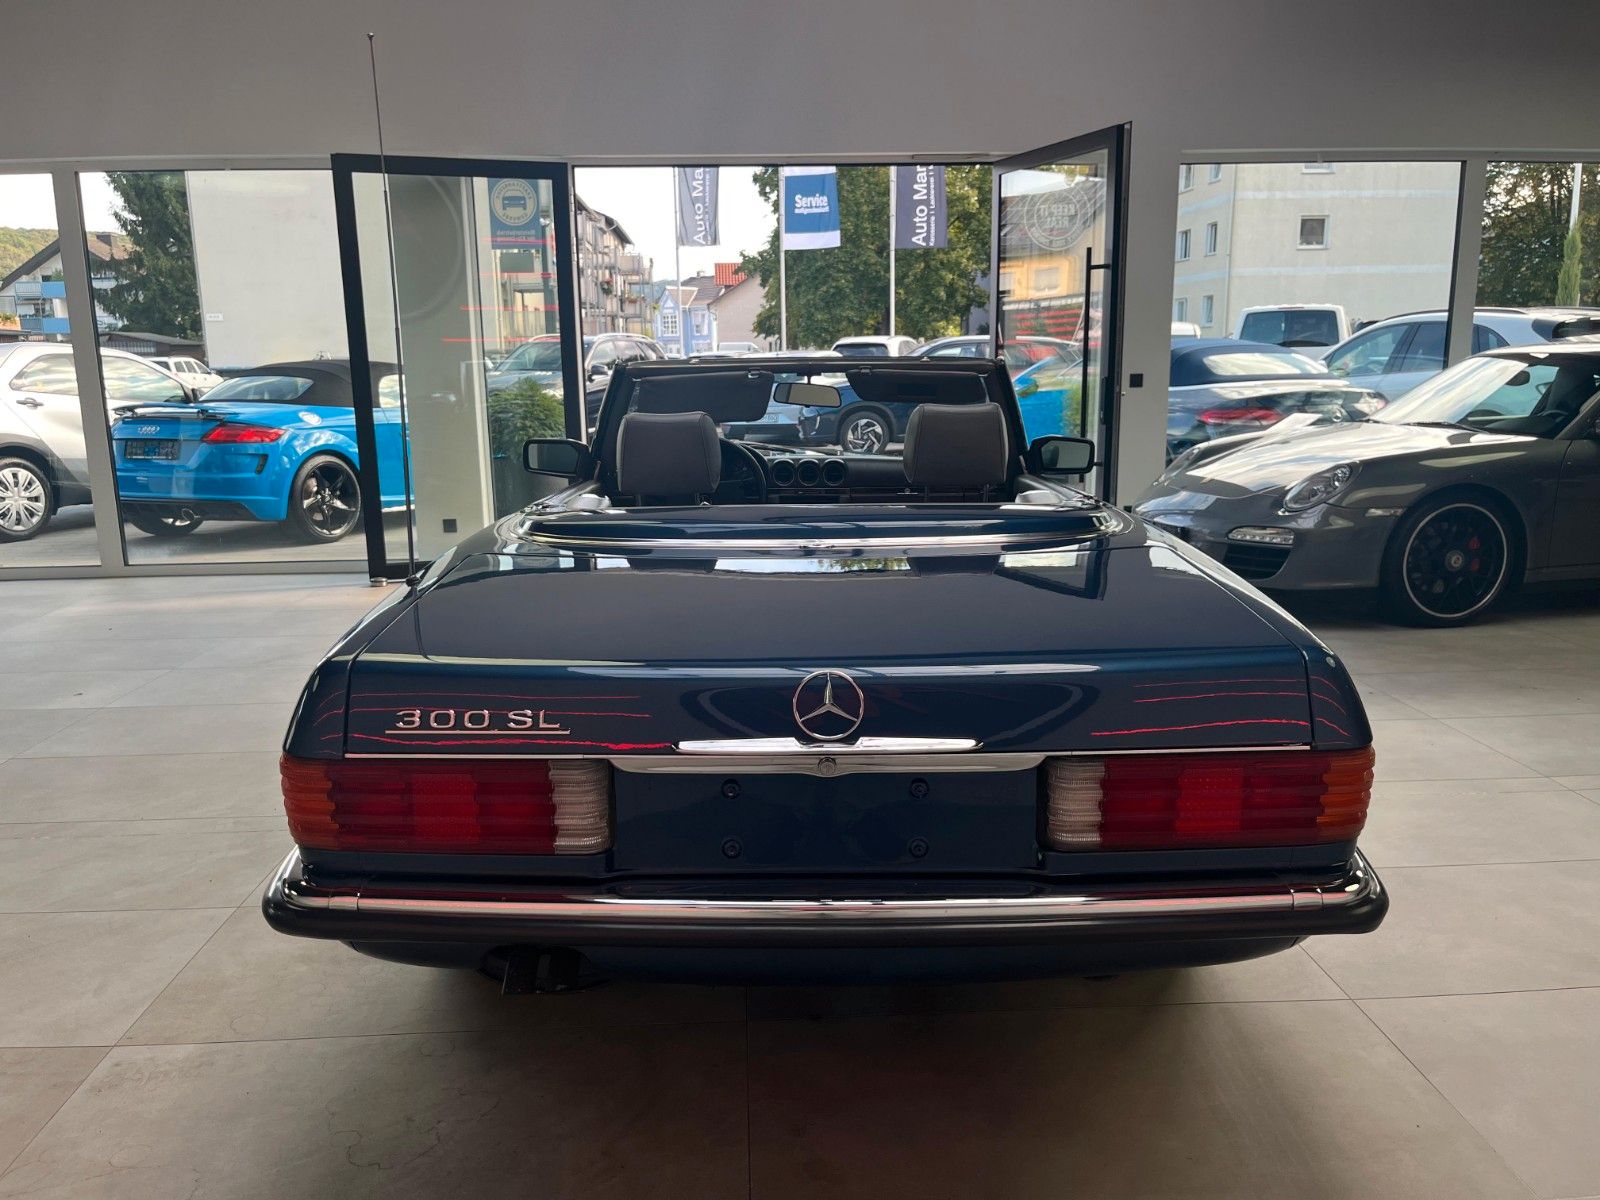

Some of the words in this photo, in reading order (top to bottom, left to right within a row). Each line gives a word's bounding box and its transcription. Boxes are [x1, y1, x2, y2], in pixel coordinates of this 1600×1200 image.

[794, 193, 829, 208] Service
[693, 203, 706, 245] Auto
[911, 205, 928, 247] Auto
[395, 709, 491, 729] 300
[507, 709, 561, 729] SL
